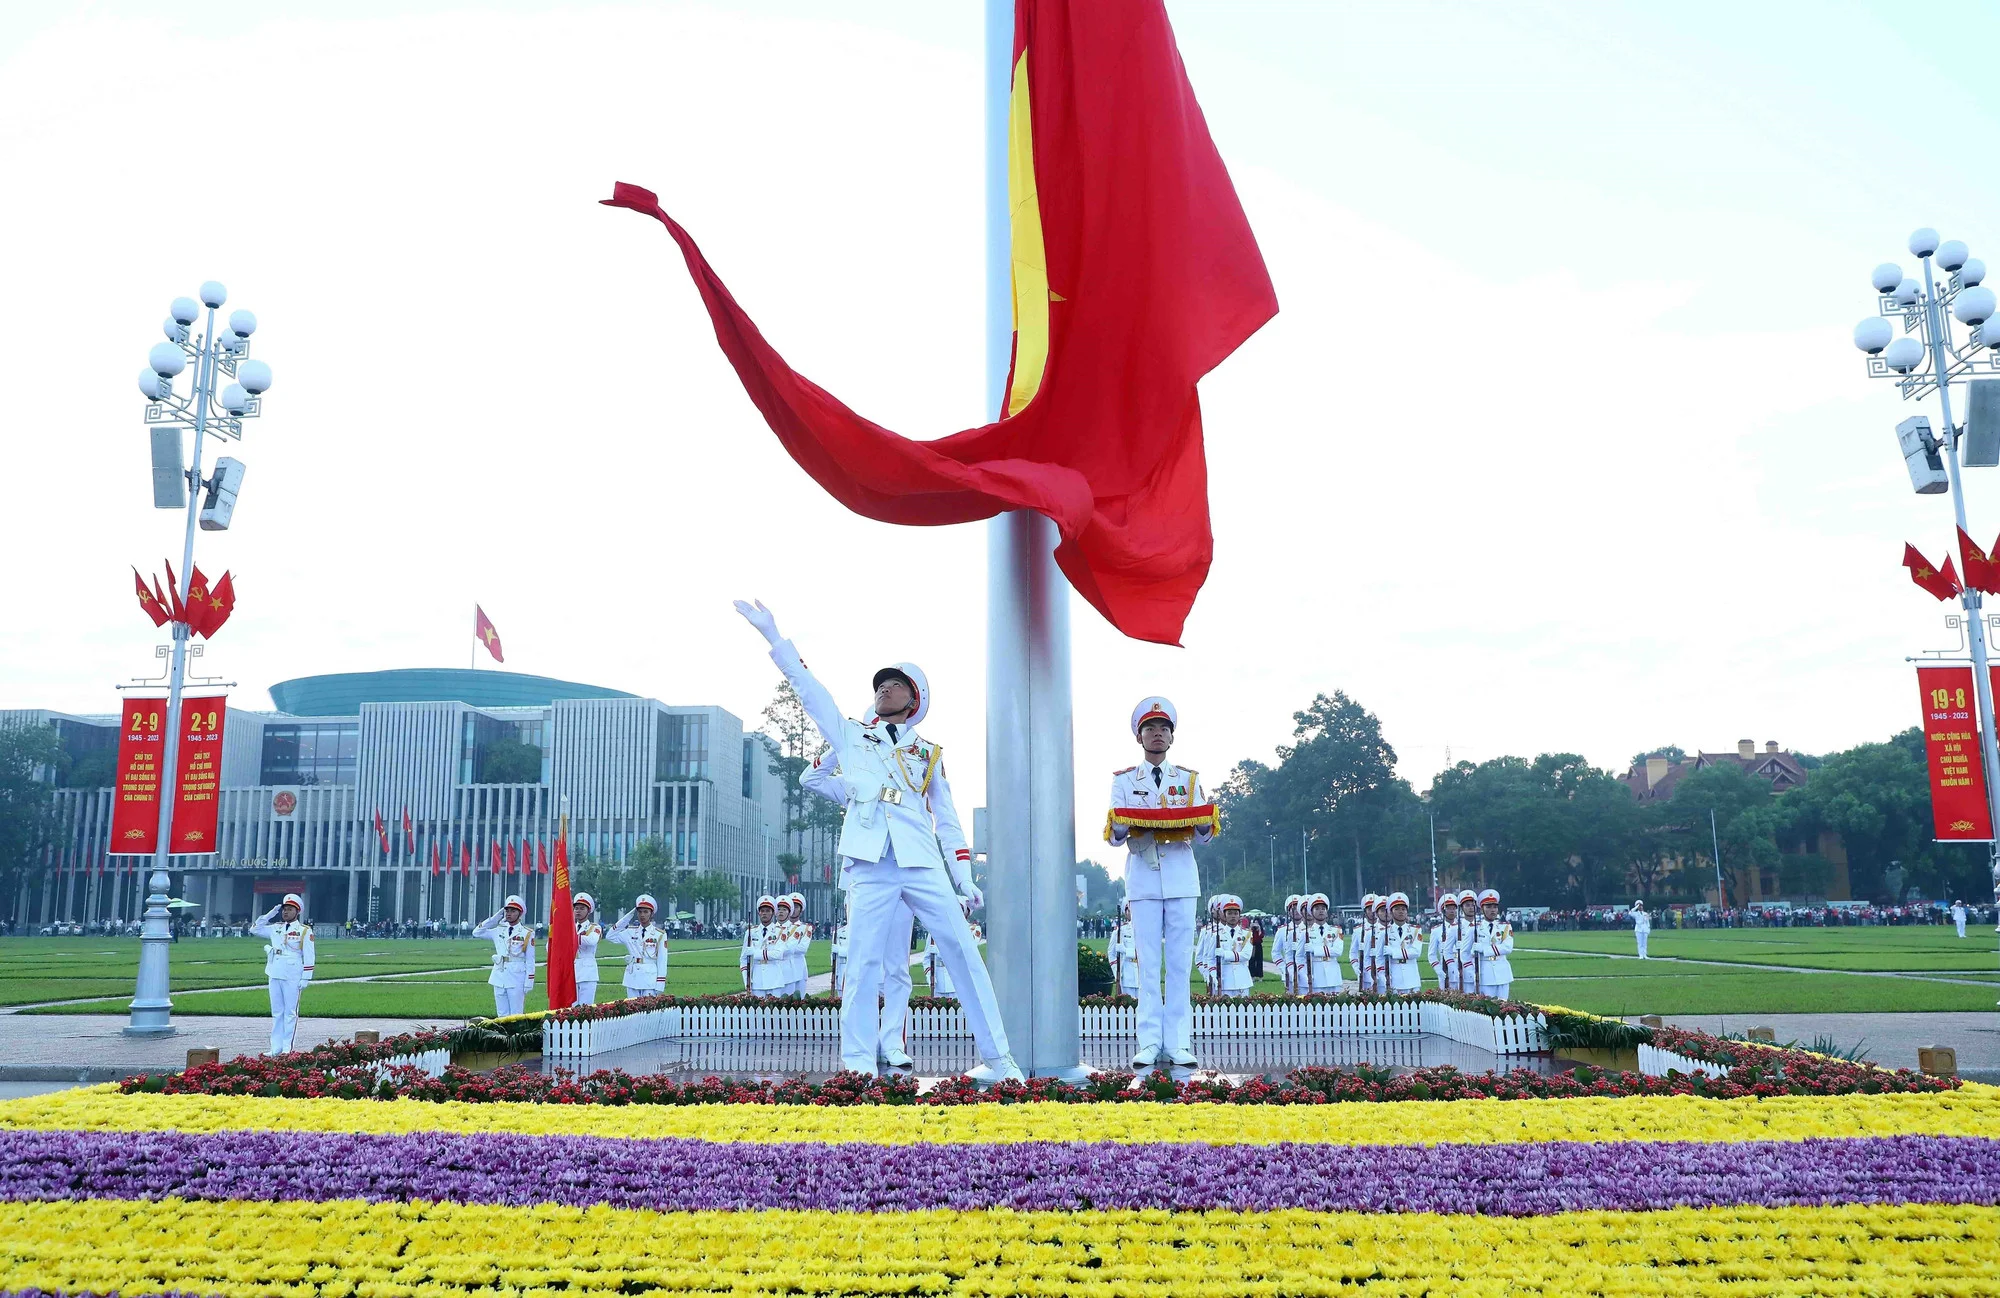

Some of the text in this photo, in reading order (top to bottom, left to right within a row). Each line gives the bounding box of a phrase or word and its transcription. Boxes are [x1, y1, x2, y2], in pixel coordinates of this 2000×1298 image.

[1931, 688, 1965, 709] 19-8
[131, 712, 158, 731] 2-9
[191, 712, 217, 731] 2-9
[1943, 766, 1955, 776] VIỆT
